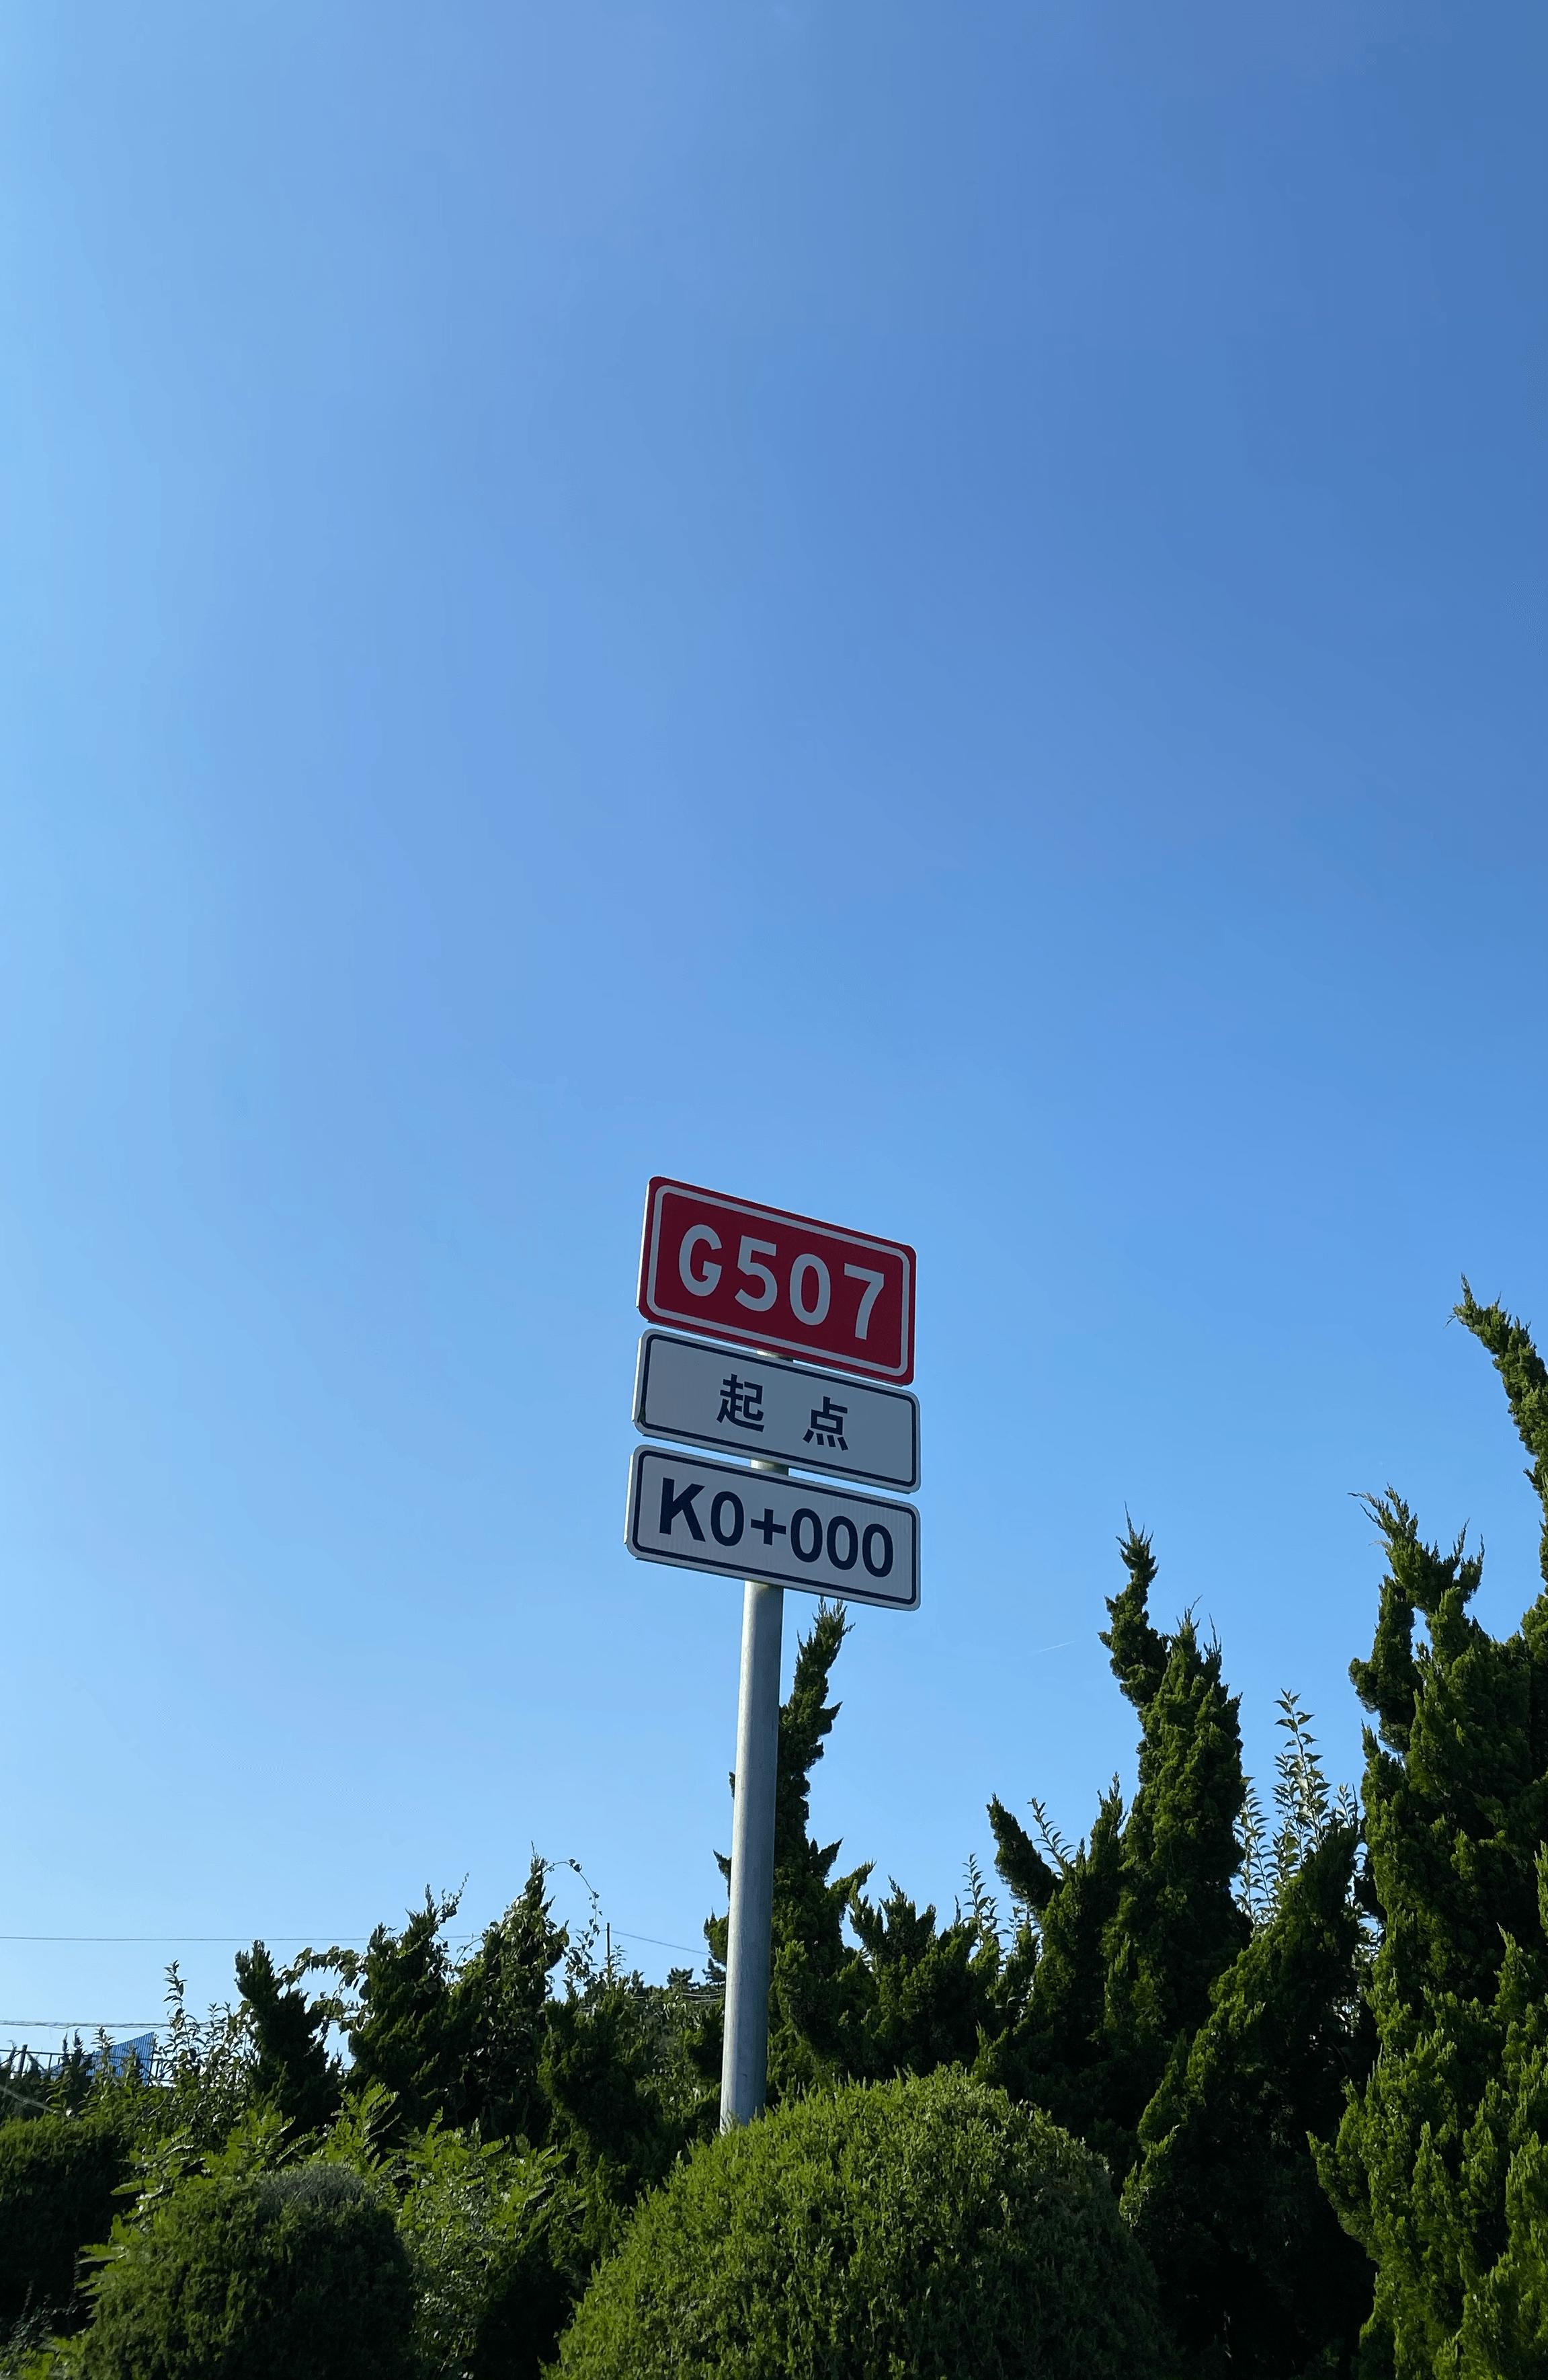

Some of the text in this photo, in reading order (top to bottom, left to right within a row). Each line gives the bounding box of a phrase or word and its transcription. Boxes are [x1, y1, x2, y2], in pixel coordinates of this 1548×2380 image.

[678, 1224, 885, 1341] G507
[716, 1373, 849, 1452] 起点
[659, 1477, 893, 1578] K0+000
